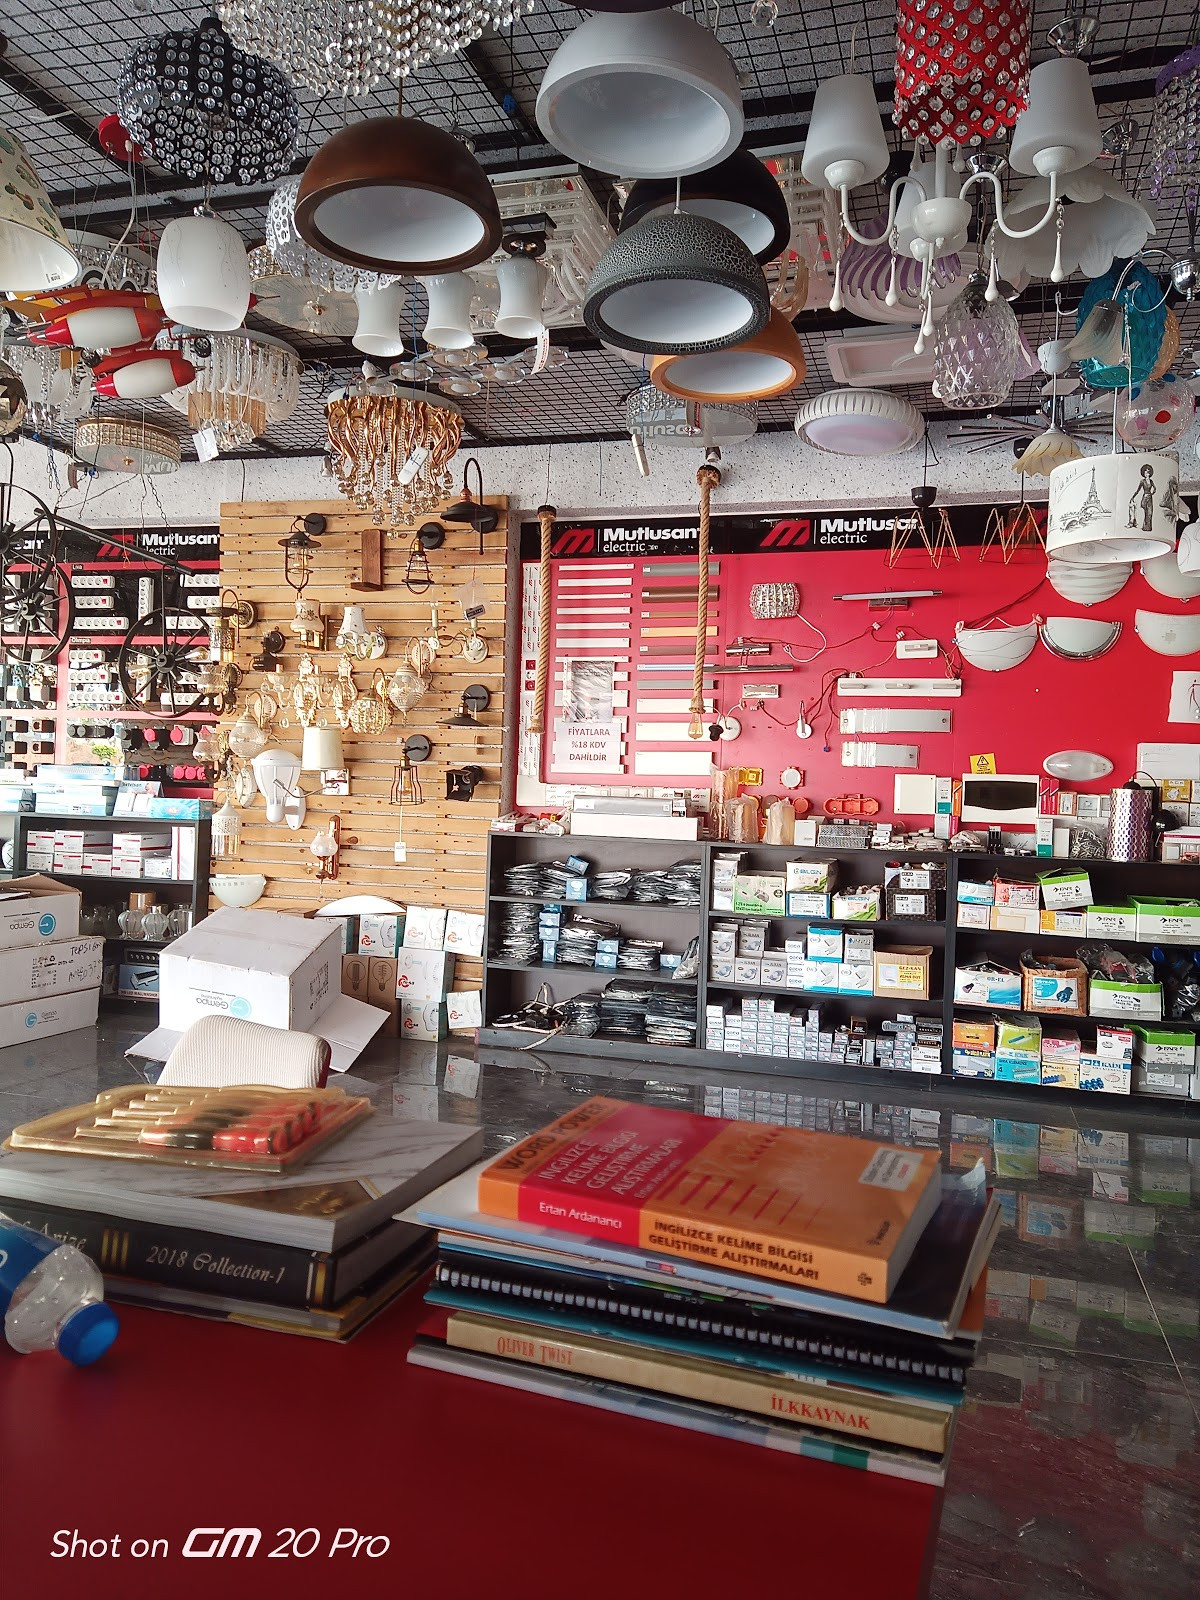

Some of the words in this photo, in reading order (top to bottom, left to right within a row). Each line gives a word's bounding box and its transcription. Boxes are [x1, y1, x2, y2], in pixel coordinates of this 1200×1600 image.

[142, 533, 218, 547] Mutlusan
[603, 526, 698, 542] Mutlusan
[820, 532, 868, 545] electric
[603, 540, 646, 553] electric
[568, 726, 610, 736] FİYATLARA
[571, 741, 588, 749] %18
[589, 741, 607, 749] KDV
[569, 752, 607, 761] DAHİLDİR
[539, 1201, 567, 1217] Ertan
[649, 1234, 718, 1257] GELİŞTİRME
[721, 1250, 819, 1280] ALIŞTIRMALARI
[717, 1234, 763, 1253] KELİME
[767, 1245, 813, 1264] BİLGİSİ
[145, 1245, 188, 1268] 2018
[192, 1252, 286, 1284] Collection-1
[496, 1336, 535, 1358] OLIVER
[539, 1345, 573, 1366] TWIST
[770, 1393, 871, 1431] İLKKAYNAK
